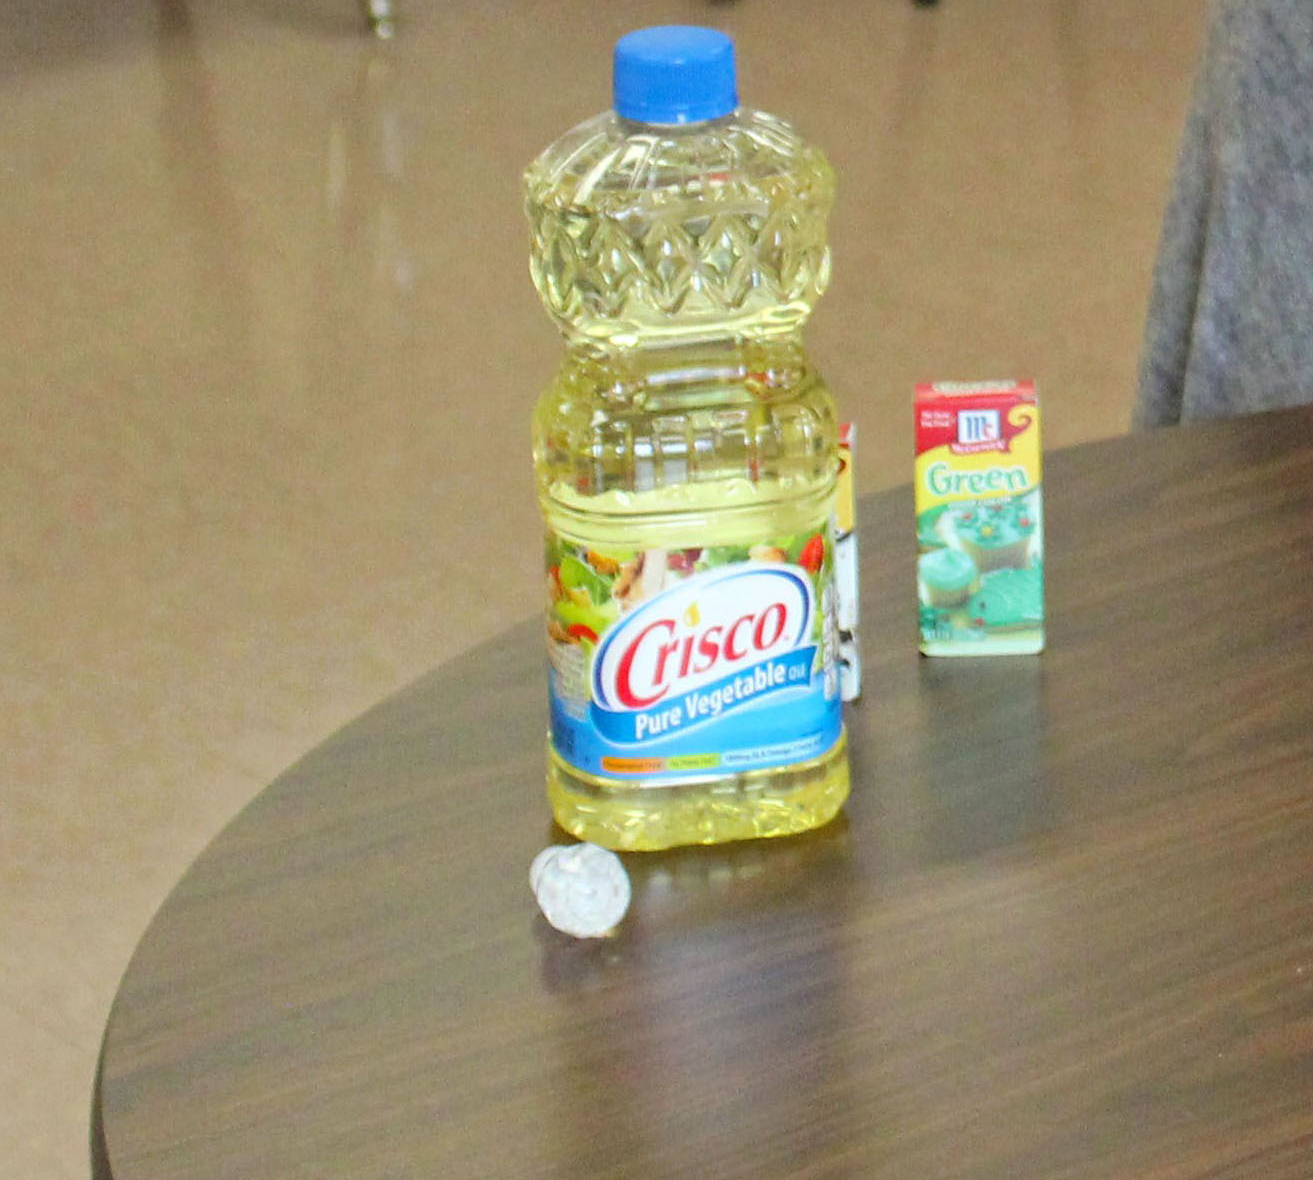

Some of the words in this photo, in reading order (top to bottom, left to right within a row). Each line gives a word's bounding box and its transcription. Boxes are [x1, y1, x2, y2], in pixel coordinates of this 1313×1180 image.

[927, 461, 1028, 496] Green
[615, 602, 787, 709] Crisco
[635, 706, 682, 740] Pure
[685, 662, 785, 716] Vegetable
